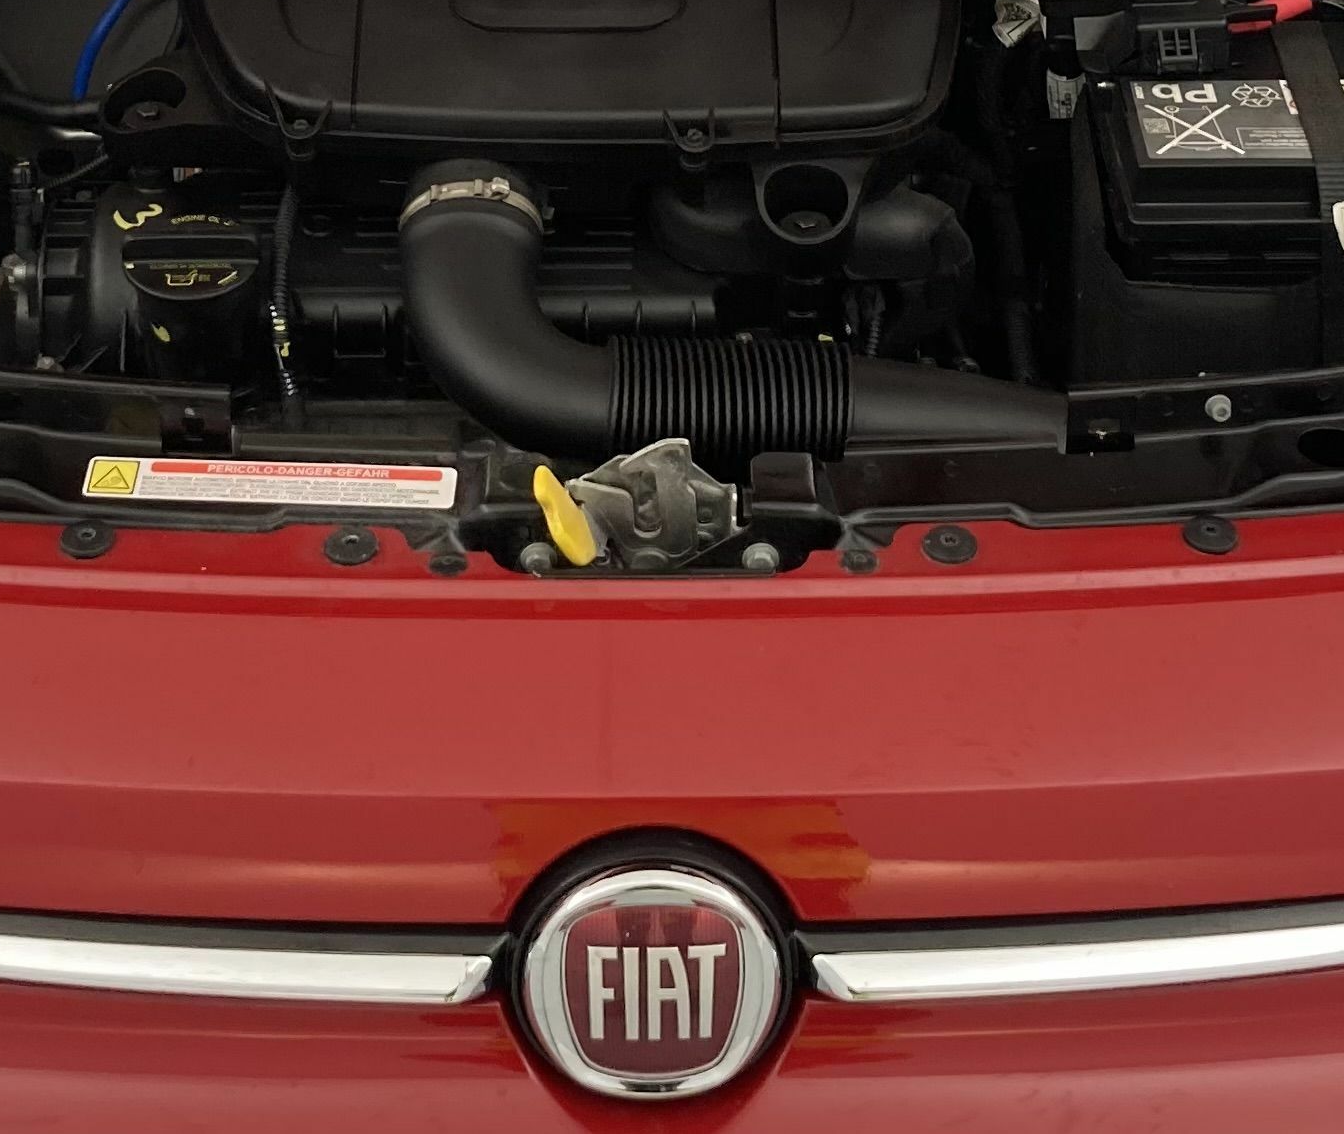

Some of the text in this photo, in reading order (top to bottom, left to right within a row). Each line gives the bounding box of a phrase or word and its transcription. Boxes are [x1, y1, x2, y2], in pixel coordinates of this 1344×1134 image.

[1151, 83, 1218, 104] Pb
[207, 464, 391, 479] PERICOLO-DANGER-GEFAHR
[586, 943, 727, 1041] FIAT
